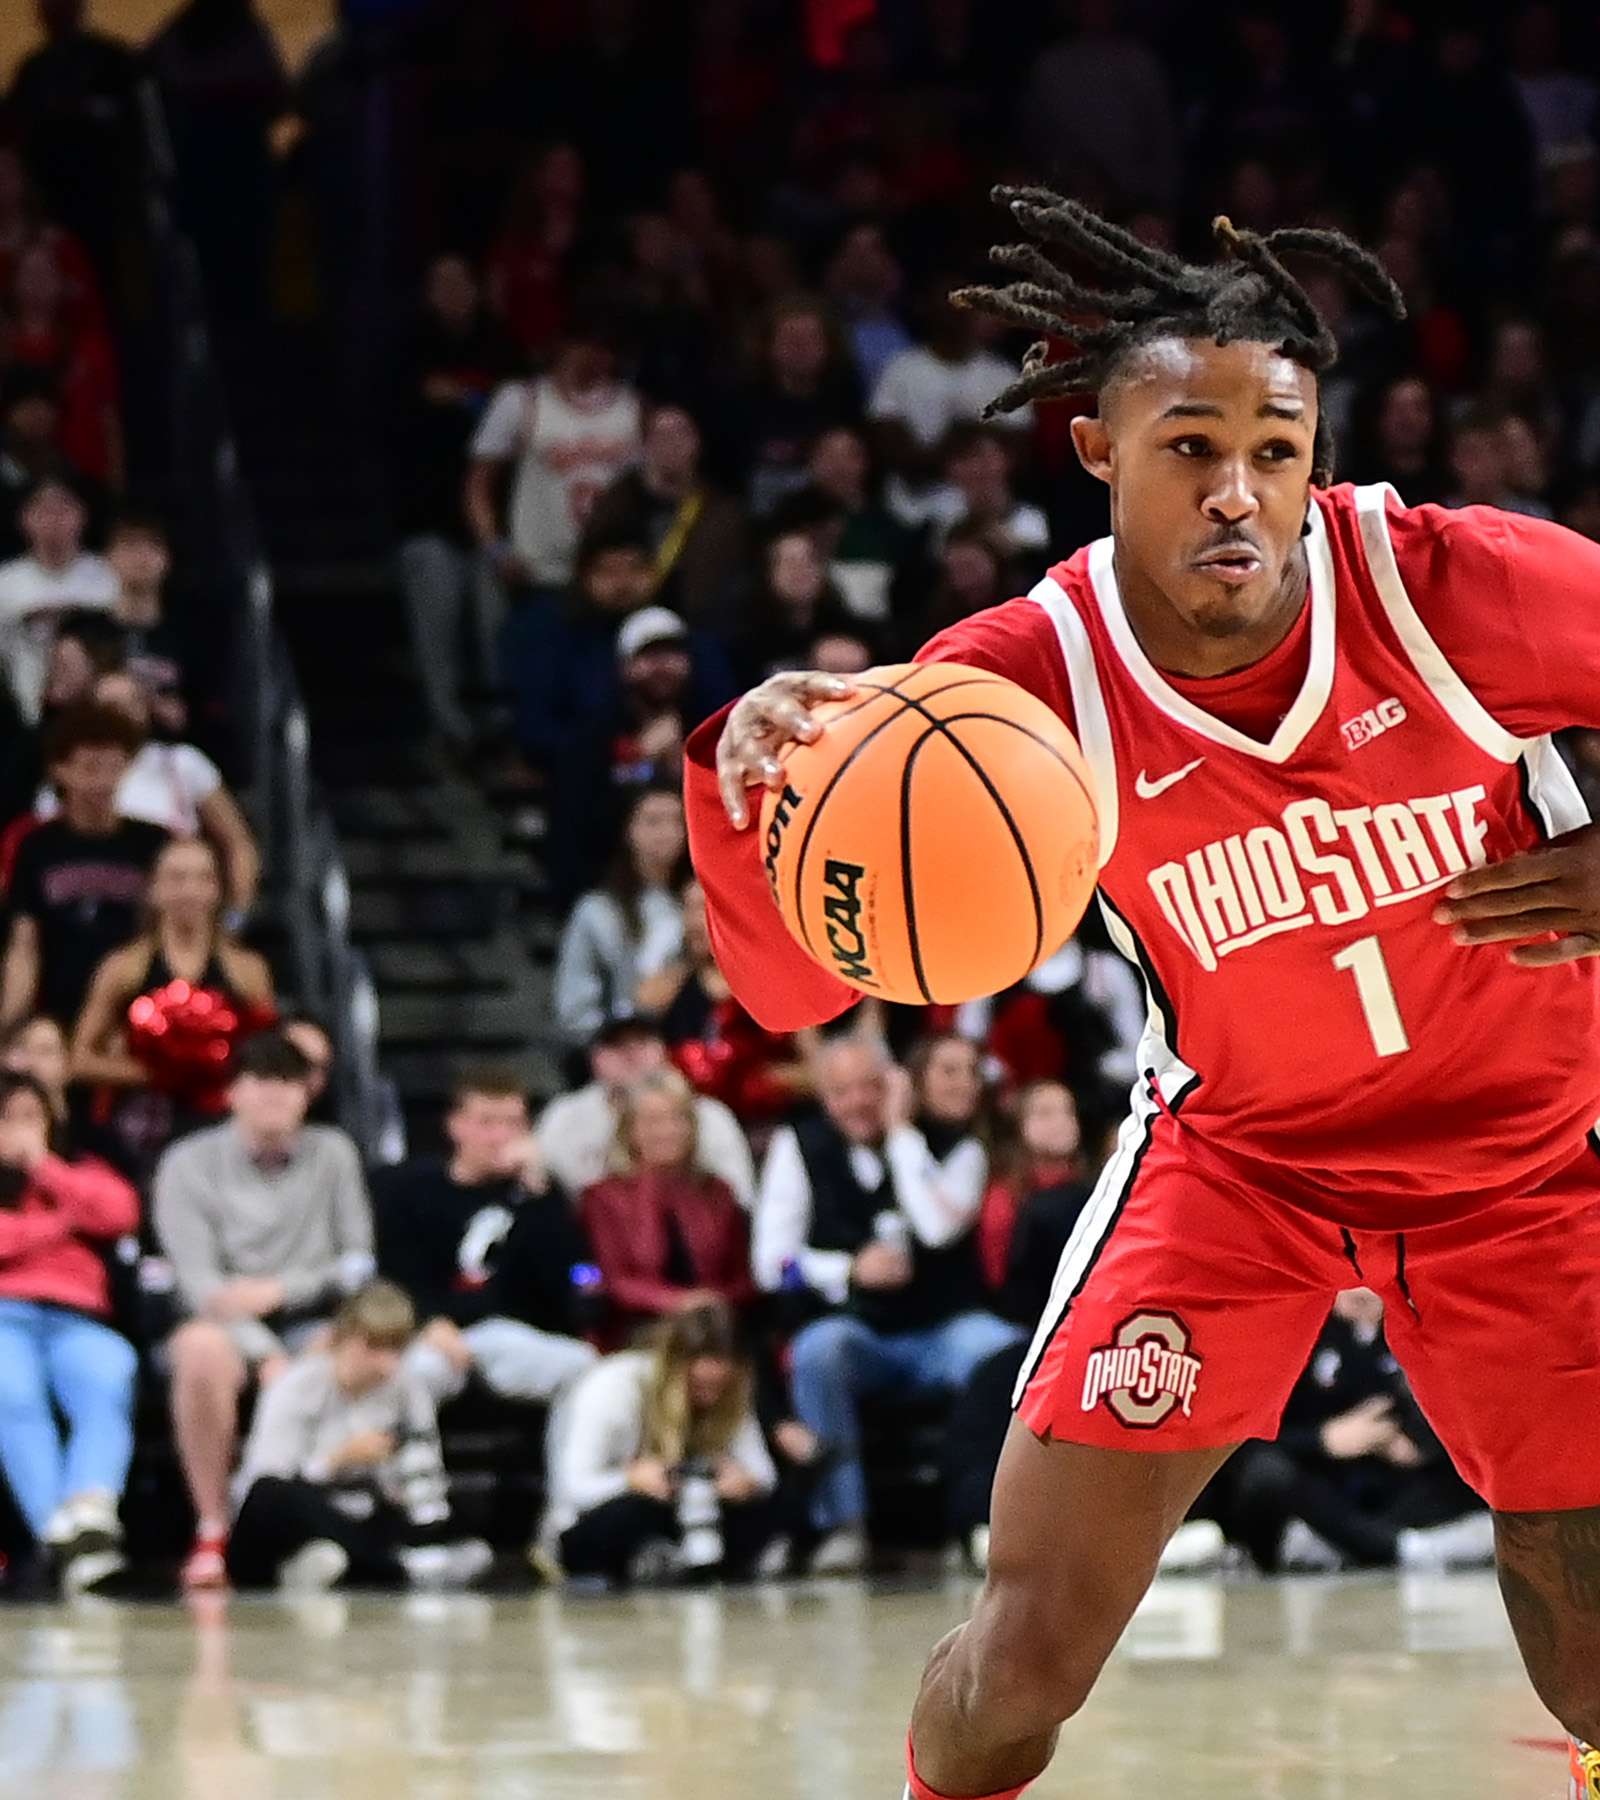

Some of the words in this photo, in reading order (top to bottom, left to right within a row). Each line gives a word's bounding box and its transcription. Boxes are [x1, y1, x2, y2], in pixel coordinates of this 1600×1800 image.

[824, 859, 881, 988] NCAA
[1147, 826, 1306, 972] OHIO
[1333, 935, 1410, 1057] 1
[1081, 1347, 1141, 1412] OHIO
[1137, 1341, 1202, 1418] STATE
